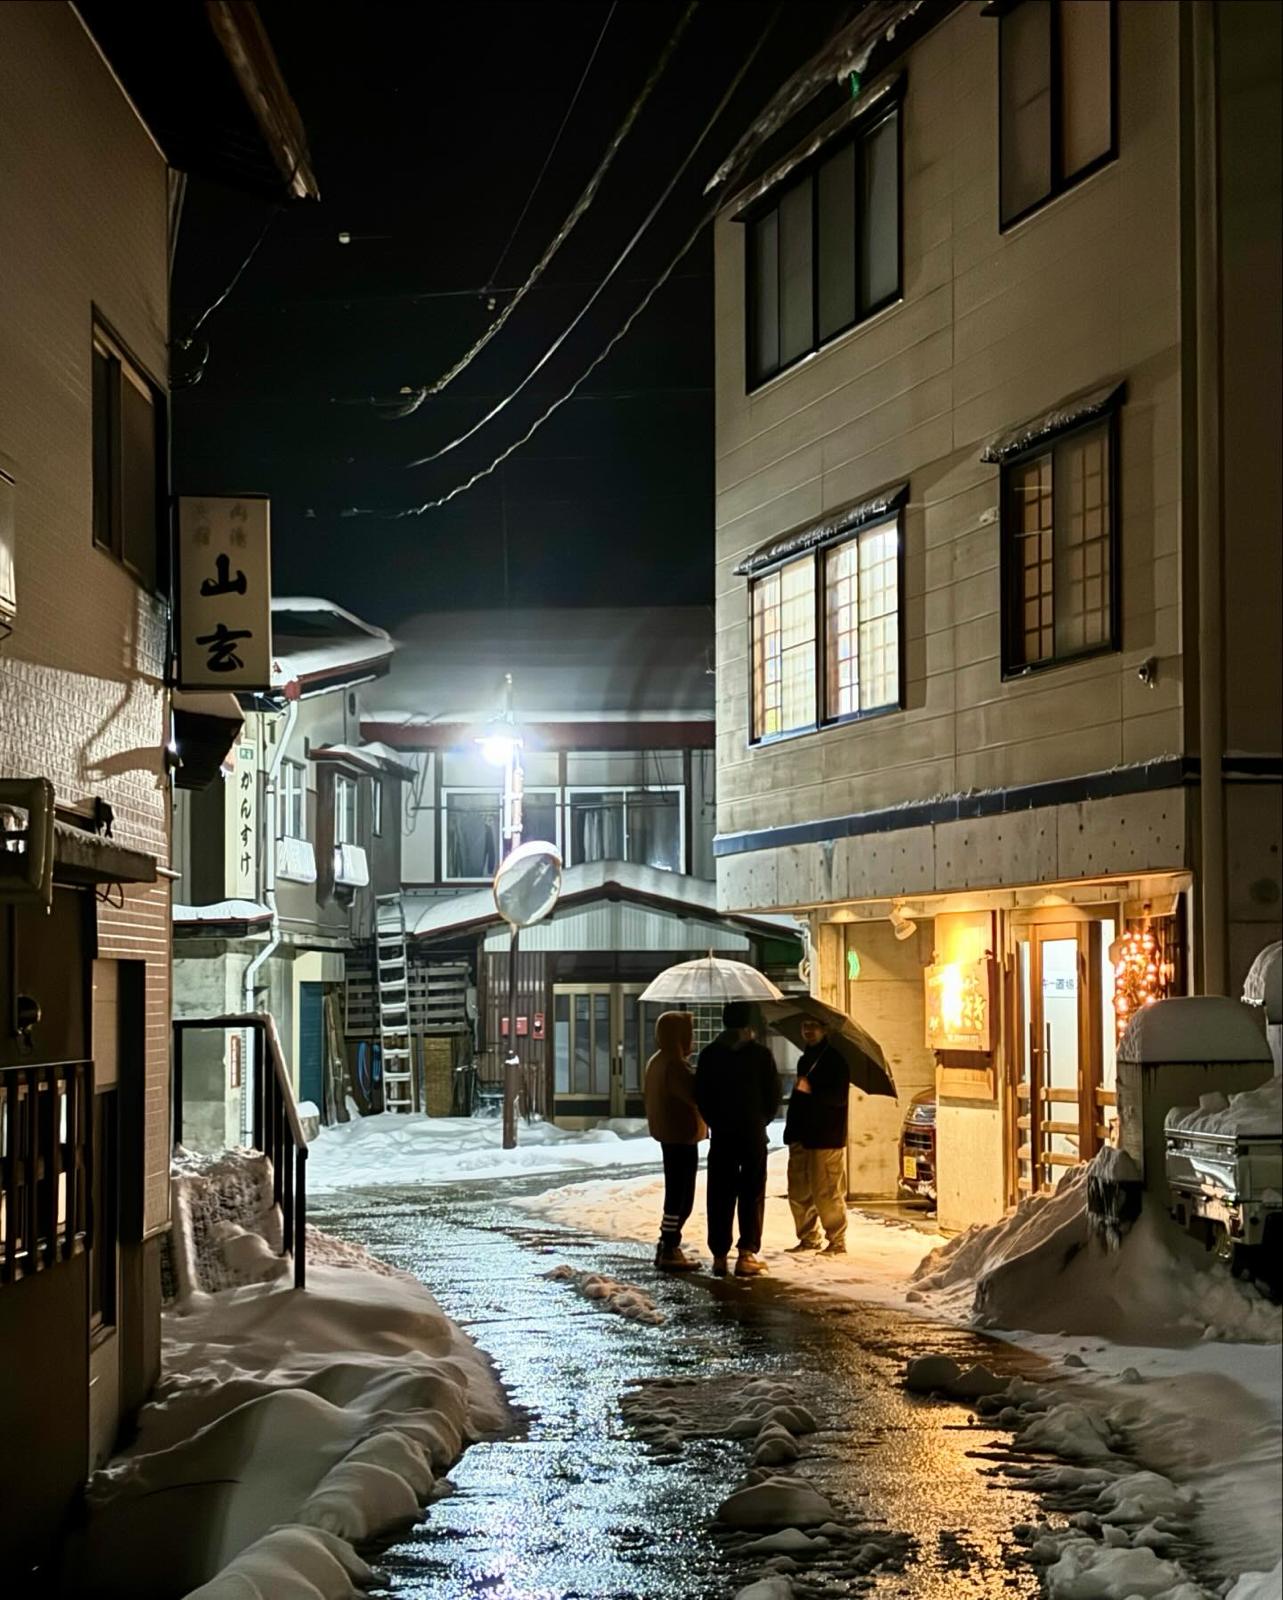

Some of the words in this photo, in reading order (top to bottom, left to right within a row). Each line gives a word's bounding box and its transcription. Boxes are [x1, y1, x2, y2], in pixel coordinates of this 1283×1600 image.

[196, 553, 253, 673] 山玄
[240, 771, 253, 876] かんすけ
